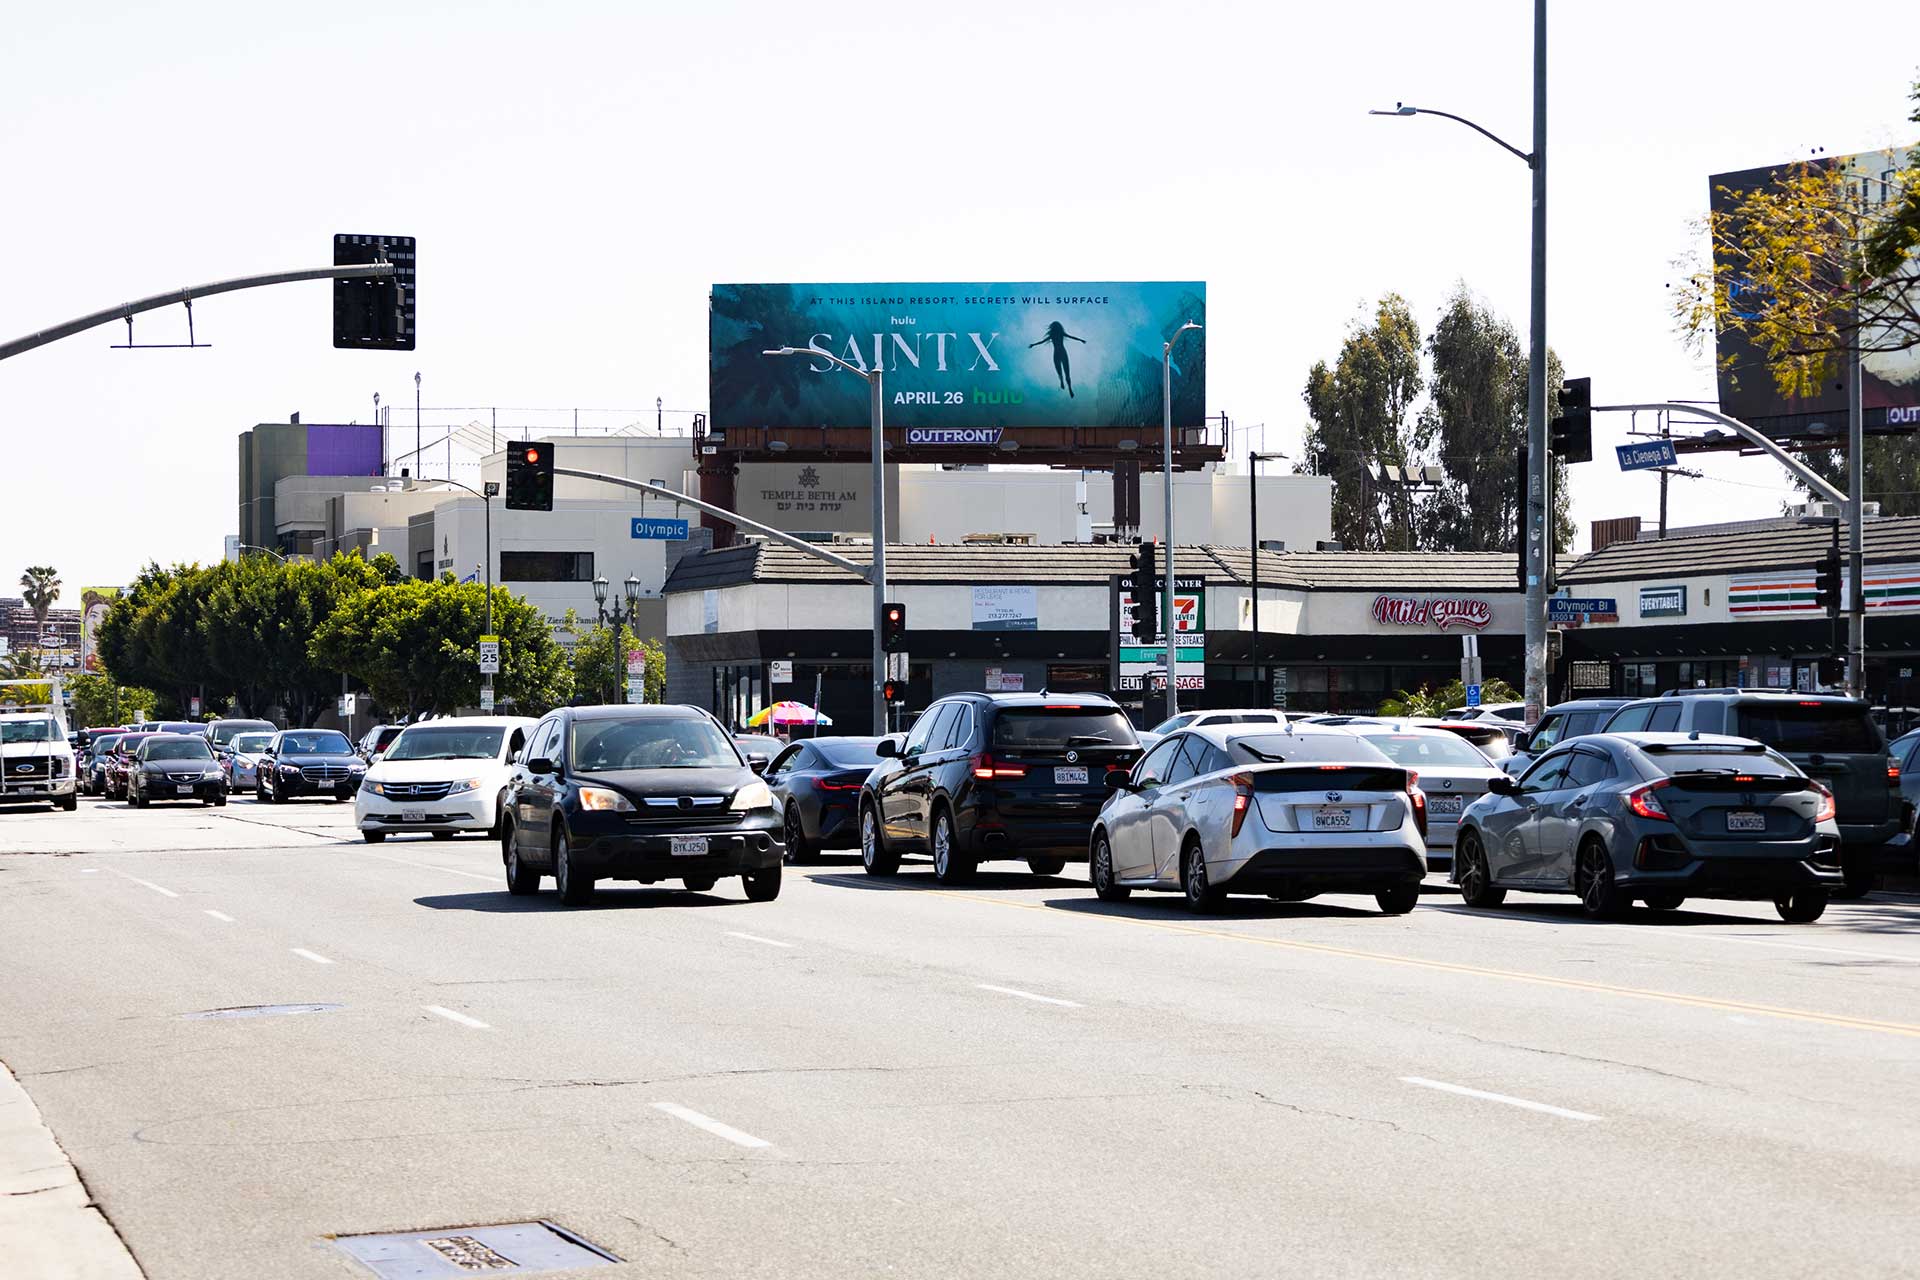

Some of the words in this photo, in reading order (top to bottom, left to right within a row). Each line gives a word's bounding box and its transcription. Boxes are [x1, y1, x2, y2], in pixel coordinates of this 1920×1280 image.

[810, 297, 823, 305] AT
[830, 297, 855, 305] THIS
[861, 297, 904, 305] ISLAND
[910, 296, 958, 305] RESORT,
[965, 296, 1016, 305] SECRETS
[1021, 296, 1050, 305] WILL
[1056, 296, 1109, 305] SURFACE
[890, 316, 916, 325] hulu
[808, 333, 957, 373] SAINT
[968, 333, 1001, 371] X
[894, 392, 940, 405] APRIL
[944, 392, 964, 405] 26
[972, 387, 1024, 405] hulu
[910, 429, 998, 443] OUTFRONT
[1621, 451, 1632, 465] La
[1633, 450, 1662, 465] Cienega
[1662, 446, 1671, 460] Bl
[760, 490, 804, 501] TEMPLE
[808, 490, 835, 501] BETH
[839, 491, 857, 501] AM
[635, 522, 684, 537] Olympic
[1165, 580, 1202, 588] ENTER
[1556, 600, 1595, 612] Olympic
[1598, 601, 1608, 611] Bl
[1641, 596, 1679, 611] EVERYTABLE
[1373, 596, 1431, 625] Mild
[1551, 613, 1568, 621] 8500
[1183, 635, 1204, 645] STEAKS
[482, 653, 498, 663] 25
[1273, 667, 1287, 685] WE
[1121, 678, 1142, 689] ELIT
[1315, 815, 1351, 826] 8WCA552
